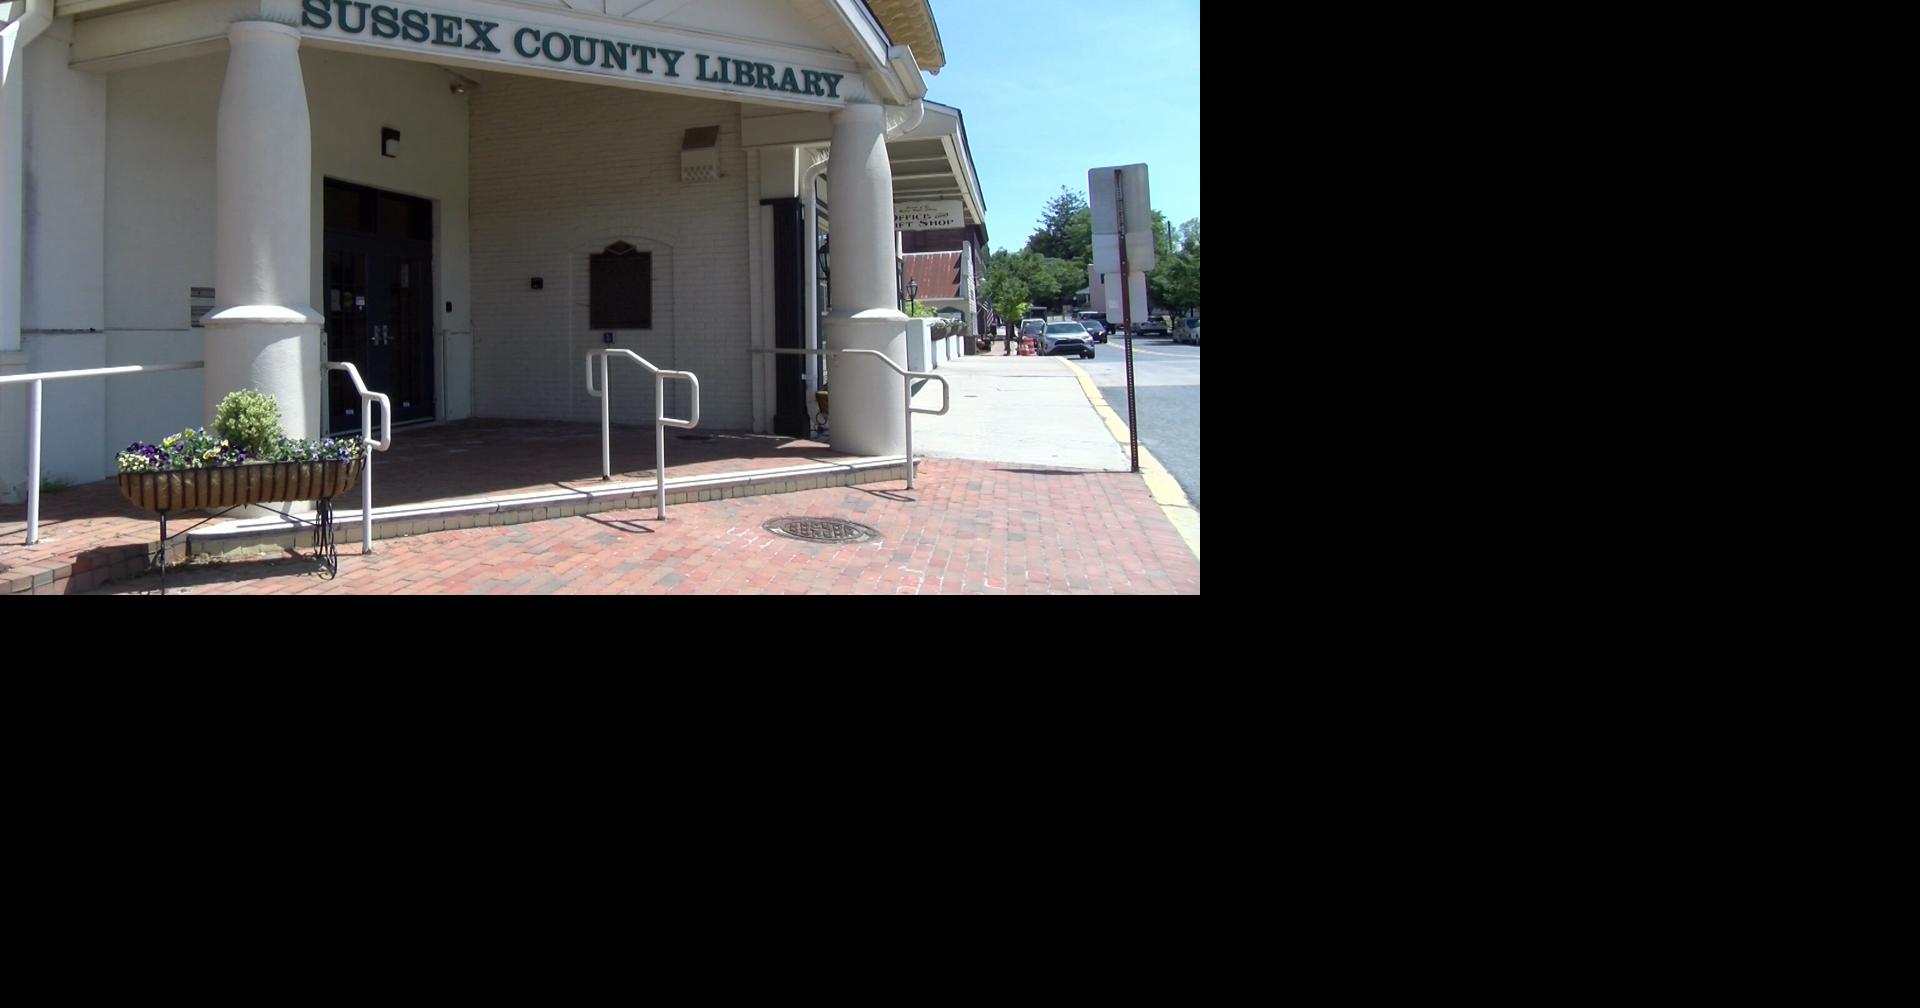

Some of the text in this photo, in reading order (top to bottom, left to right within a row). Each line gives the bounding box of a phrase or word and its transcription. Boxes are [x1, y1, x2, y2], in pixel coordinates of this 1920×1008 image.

[301, 0, 844, 99] SUSSEX COUNTY LIBRARY
[919, 219, 954, 227] SHOP
